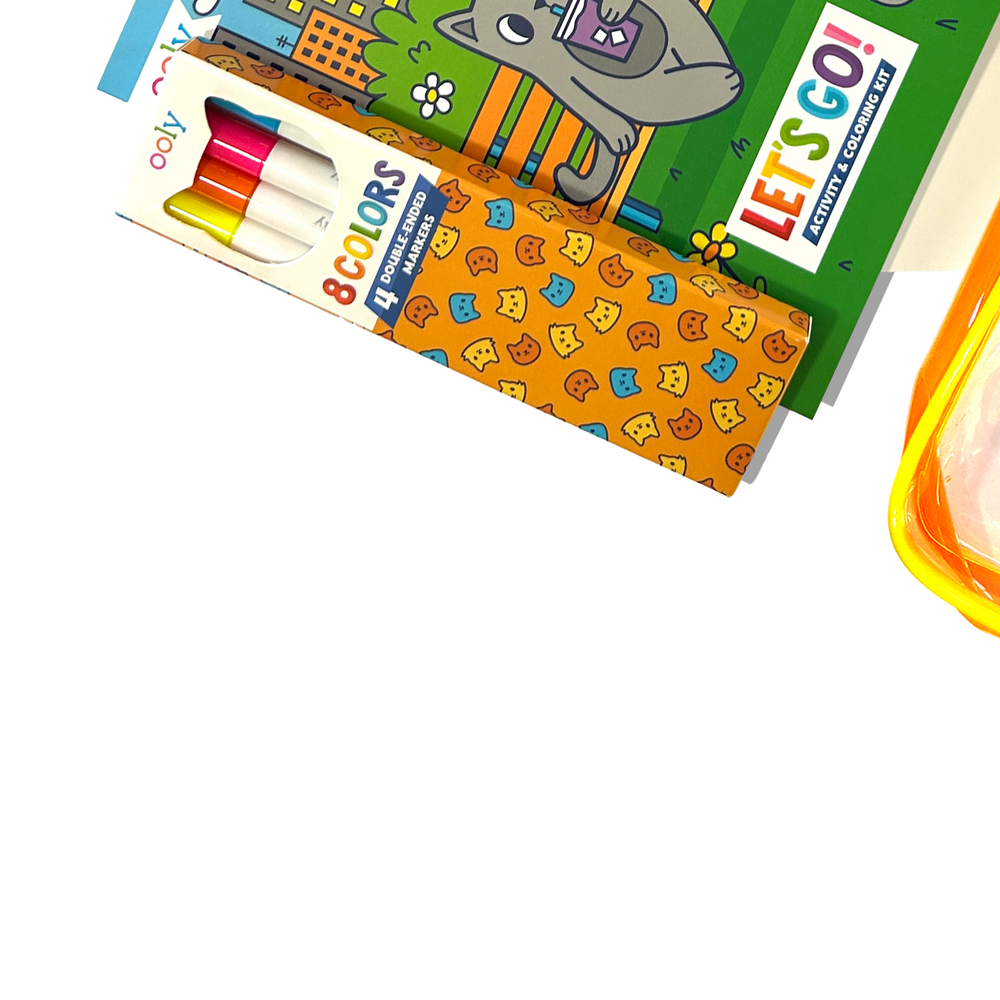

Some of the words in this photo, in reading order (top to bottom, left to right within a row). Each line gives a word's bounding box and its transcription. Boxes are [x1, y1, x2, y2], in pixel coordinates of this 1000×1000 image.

[150, 110, 187, 170] ooly
[740, 117, 830, 242] LET'S
[797, 22, 875, 120] GO!
[809, 173, 843, 236] ACTIVITY
[837, 163, 849, 173] &
[843, 92, 880, 160] COLORING
[873, 68, 891, 92] KIT
[333, 159, 406, 281] COLORS
[380, 190, 427, 285] DOUBLE-ENDED
[402, 213, 435, 276] MARKERS
[322, 277, 357, 306] 8
[373, 286, 400, 311] 4
